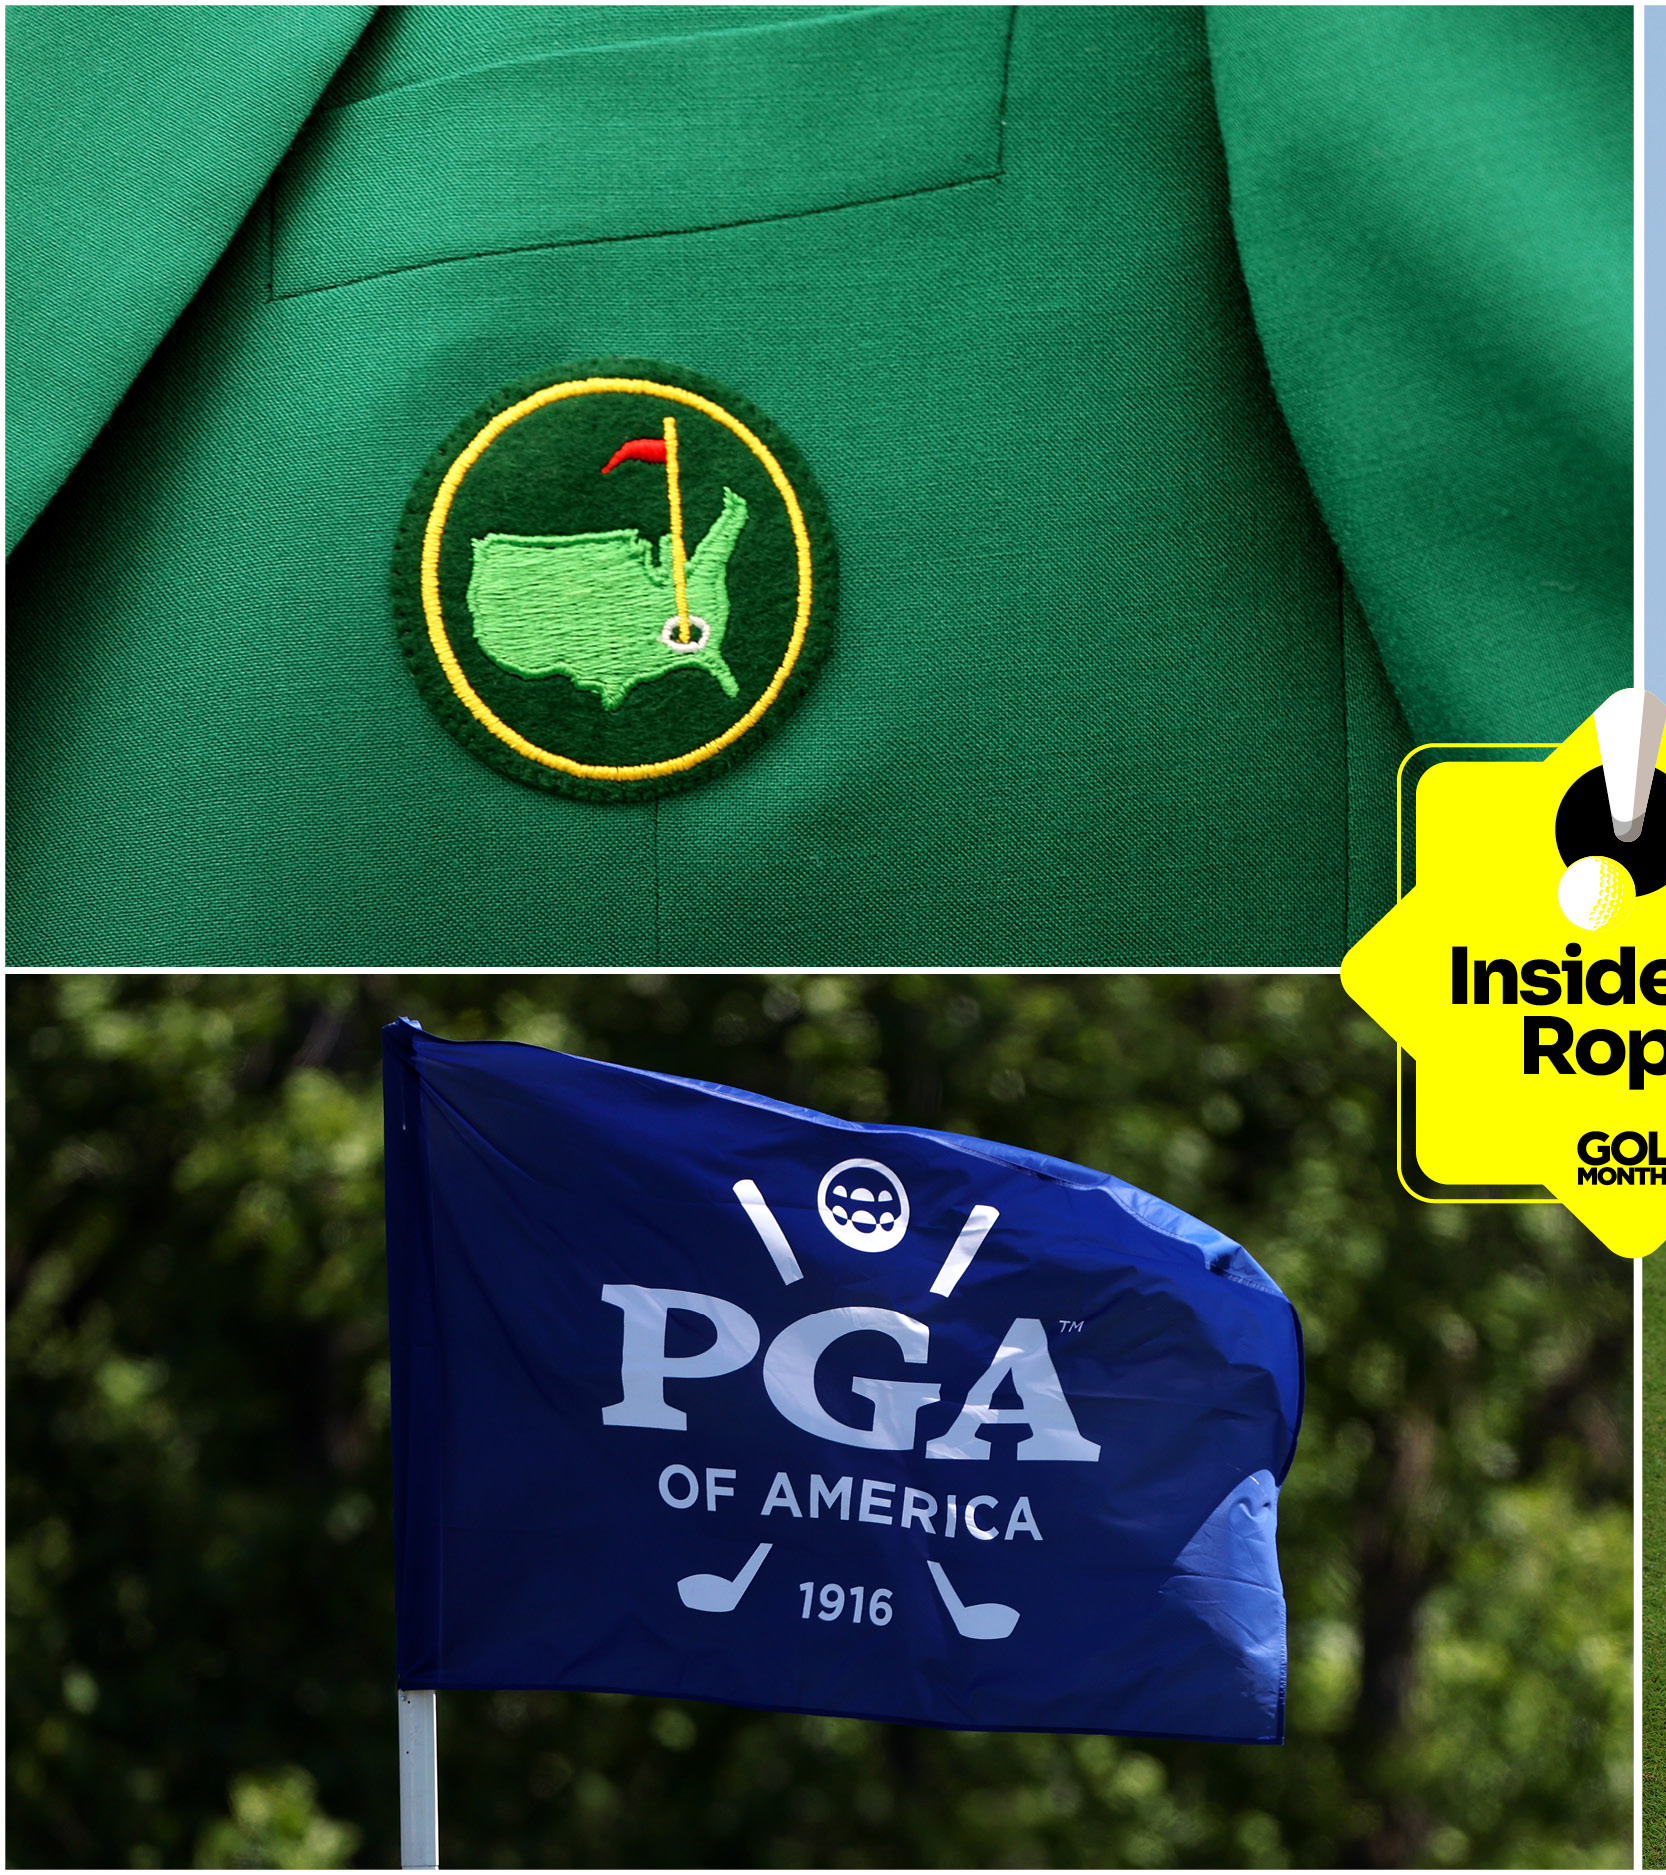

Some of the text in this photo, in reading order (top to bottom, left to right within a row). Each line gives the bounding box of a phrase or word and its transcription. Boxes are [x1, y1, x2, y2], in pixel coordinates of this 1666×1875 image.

[601, 1284, 1101, 1462] PGA
[658, 1464, 1043, 1541] OF AMERICA
[800, 1581, 894, 1627] 1916
